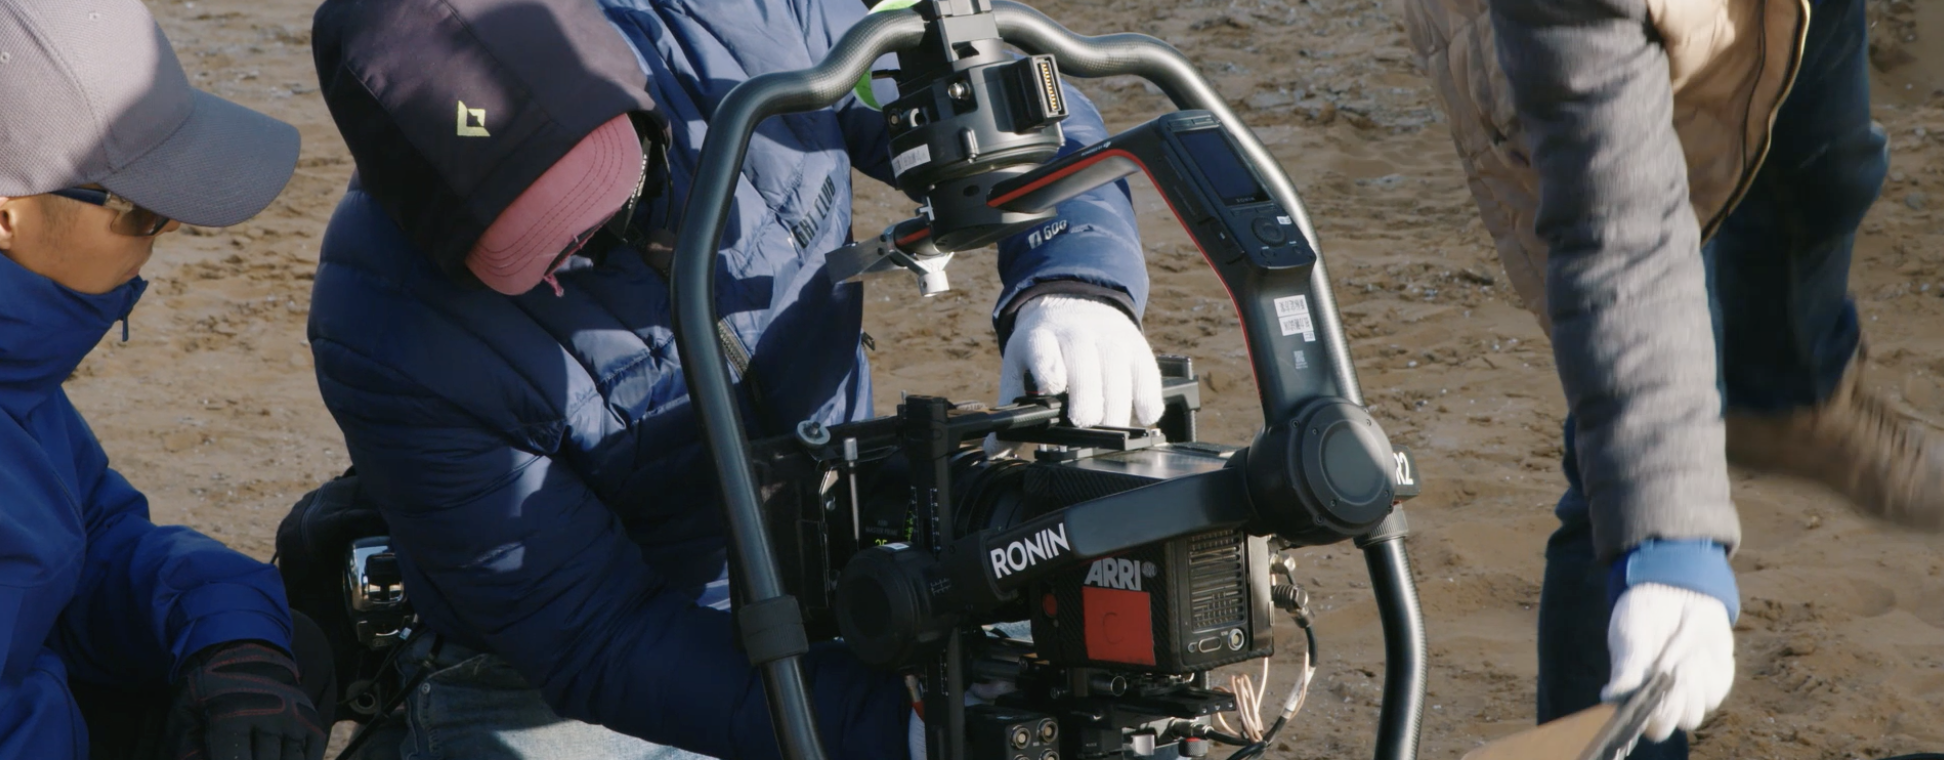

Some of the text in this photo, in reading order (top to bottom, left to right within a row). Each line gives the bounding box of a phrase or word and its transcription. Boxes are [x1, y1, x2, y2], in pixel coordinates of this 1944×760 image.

[813, 174, 836, 220] CLUB
[990, 523, 1071, 578] RONIN
[1084, 557, 1141, 591] ARRI
